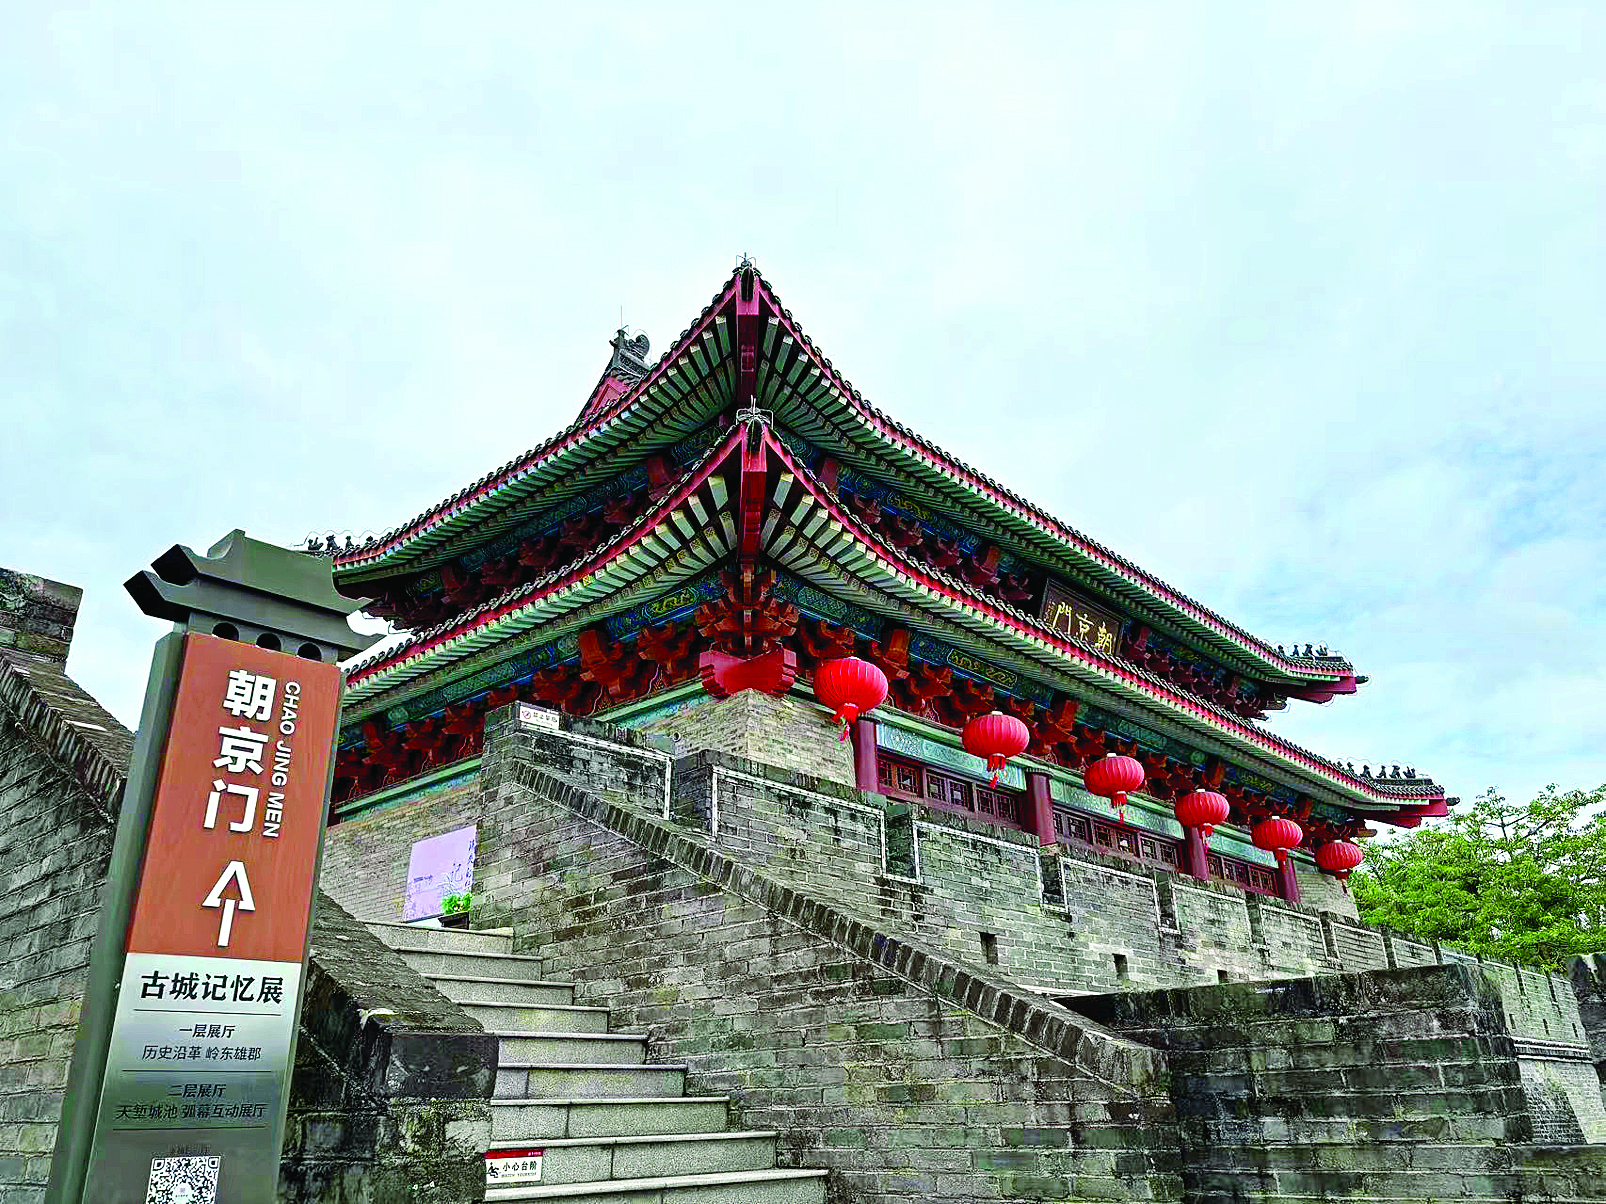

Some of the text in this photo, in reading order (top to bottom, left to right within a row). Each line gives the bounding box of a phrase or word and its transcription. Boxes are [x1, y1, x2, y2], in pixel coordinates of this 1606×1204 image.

[203, 669, 277, 833] 朝京门
[262, 681, 301, 838] CHAO JING MEN
[140, 970, 284, 1005] 古城记忆展
[179, 1023, 236, 1039] 一层展厅
[141, 1045, 262, 1061] 历史沿革 岭东雄郡
[167, 1083, 226, 1098] 二层展厅
[115, 1103, 266, 1119] 天堑城池 弧幕互动展厅
[503, 1161, 537, 1171] 小心台阶
